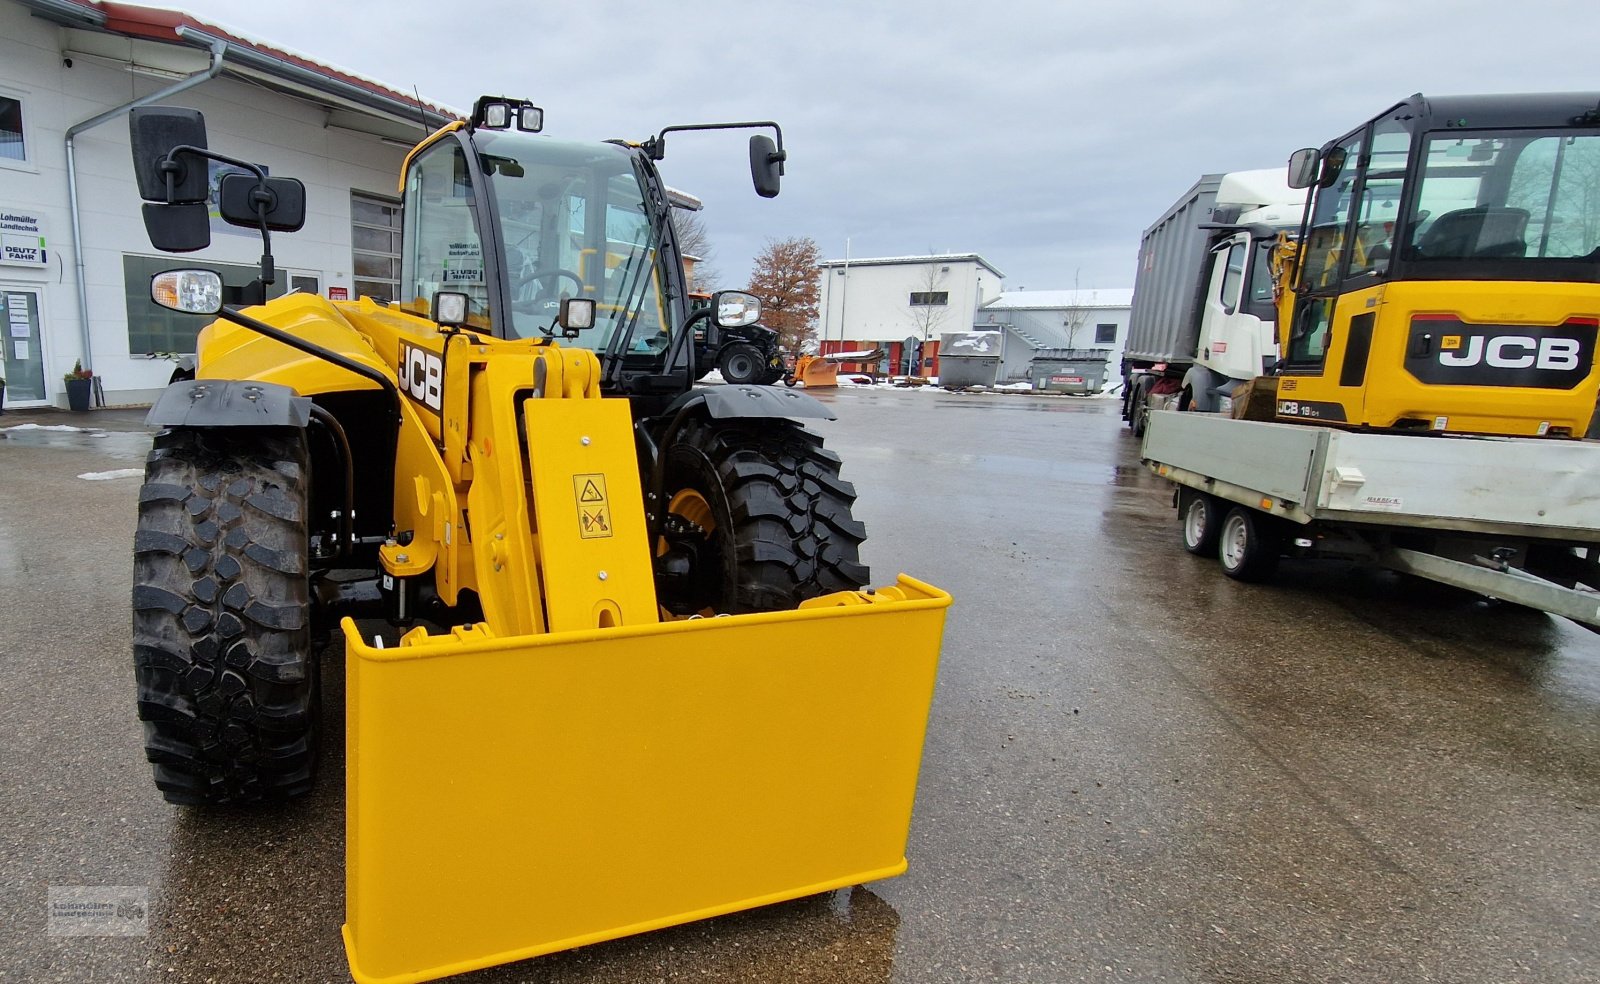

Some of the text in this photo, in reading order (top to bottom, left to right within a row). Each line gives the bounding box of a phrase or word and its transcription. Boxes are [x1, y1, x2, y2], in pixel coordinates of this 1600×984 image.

[0, 213, 37, 224] Lohmüller
[0, 222, 39, 232] Landtechnik
[5, 246, 37, 255] DEUTZ
[9, 252, 35, 260] FAHR
[1439, 335, 1580, 371] JCB
[399, 345, 442, 410] JCB
[1279, 401, 1299, 414] JCB
